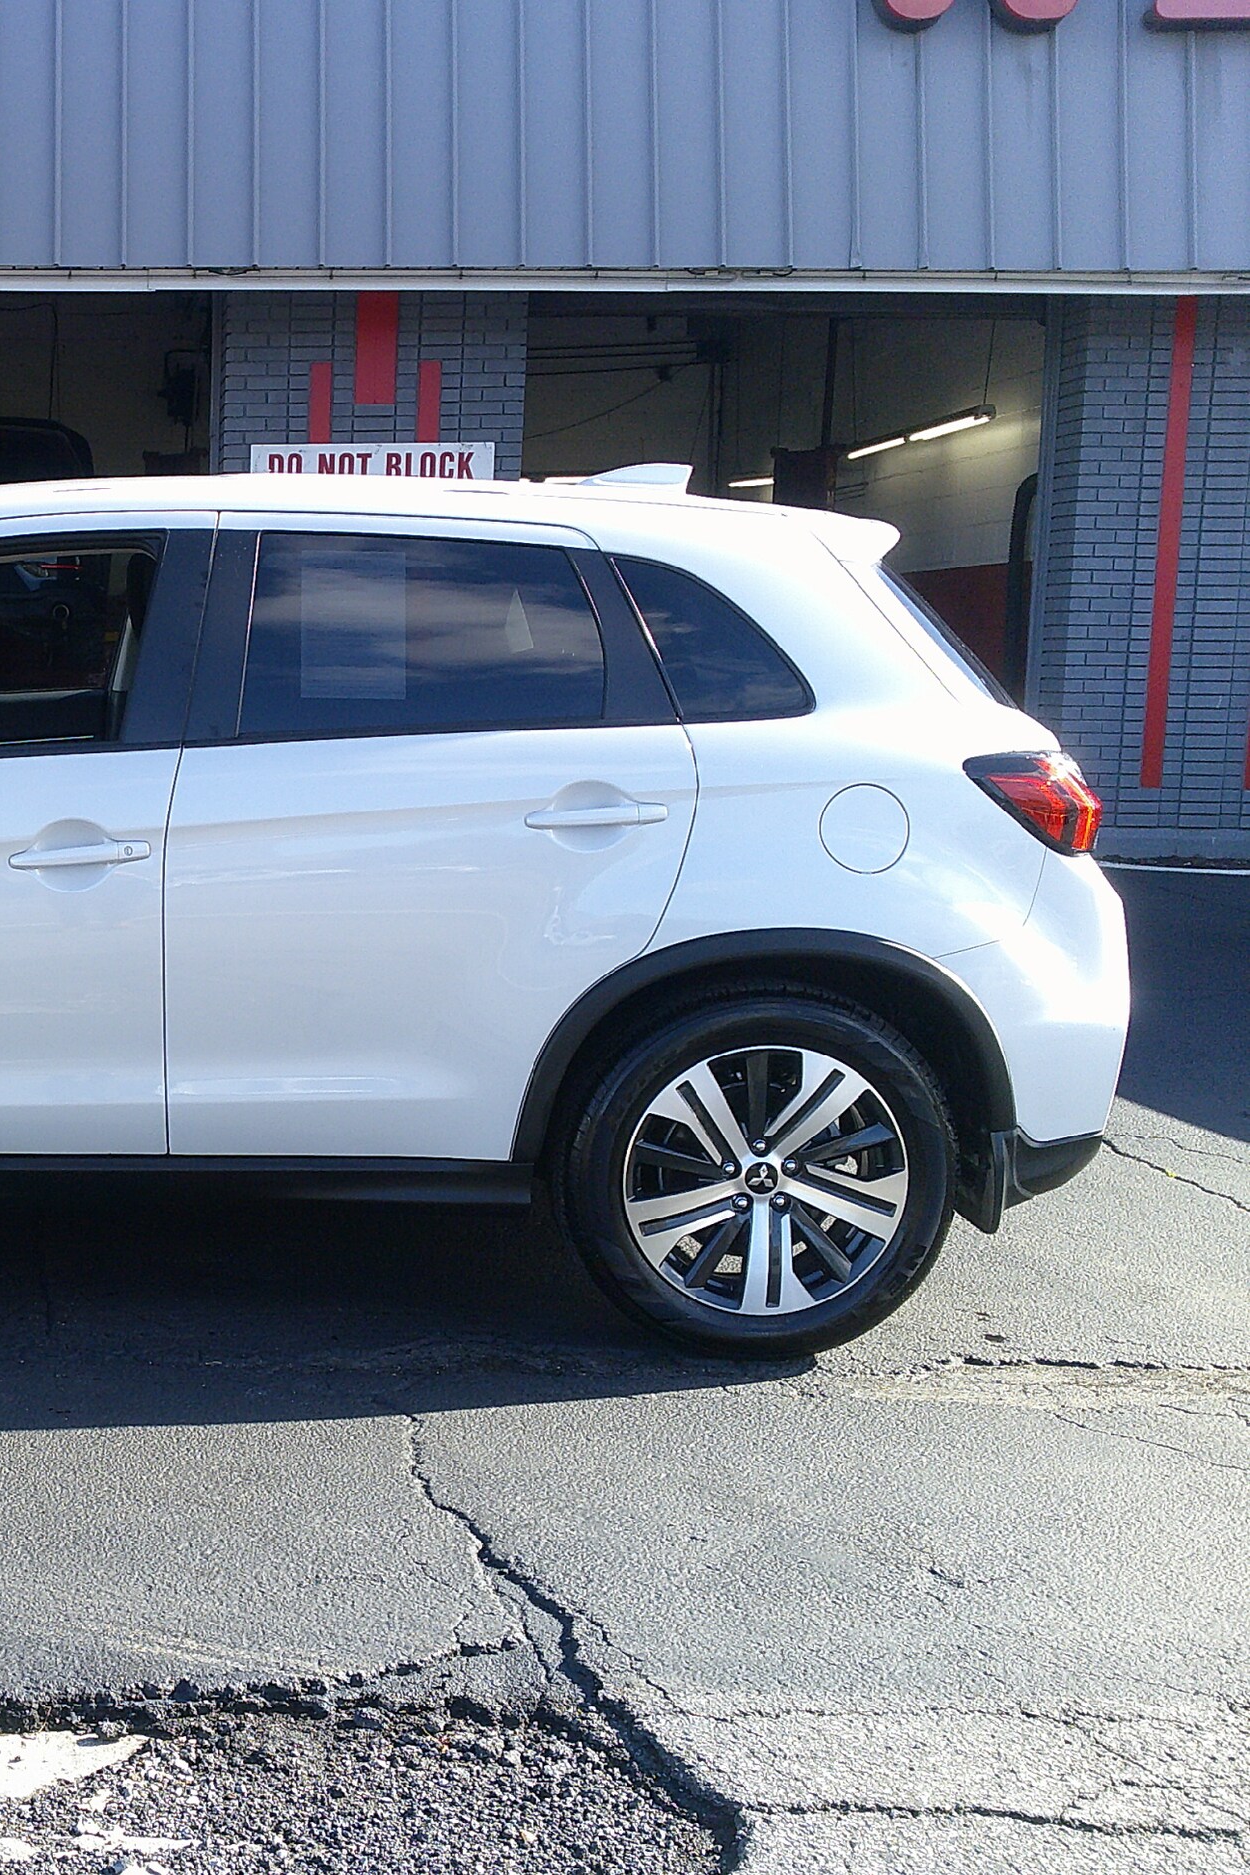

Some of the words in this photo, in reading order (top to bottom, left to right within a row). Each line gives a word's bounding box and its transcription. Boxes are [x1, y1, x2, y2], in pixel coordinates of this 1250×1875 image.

[268, 453, 303, 473] DO
[318, 453, 372, 475] NOT
[386, 451, 475, 479] BLOCK
